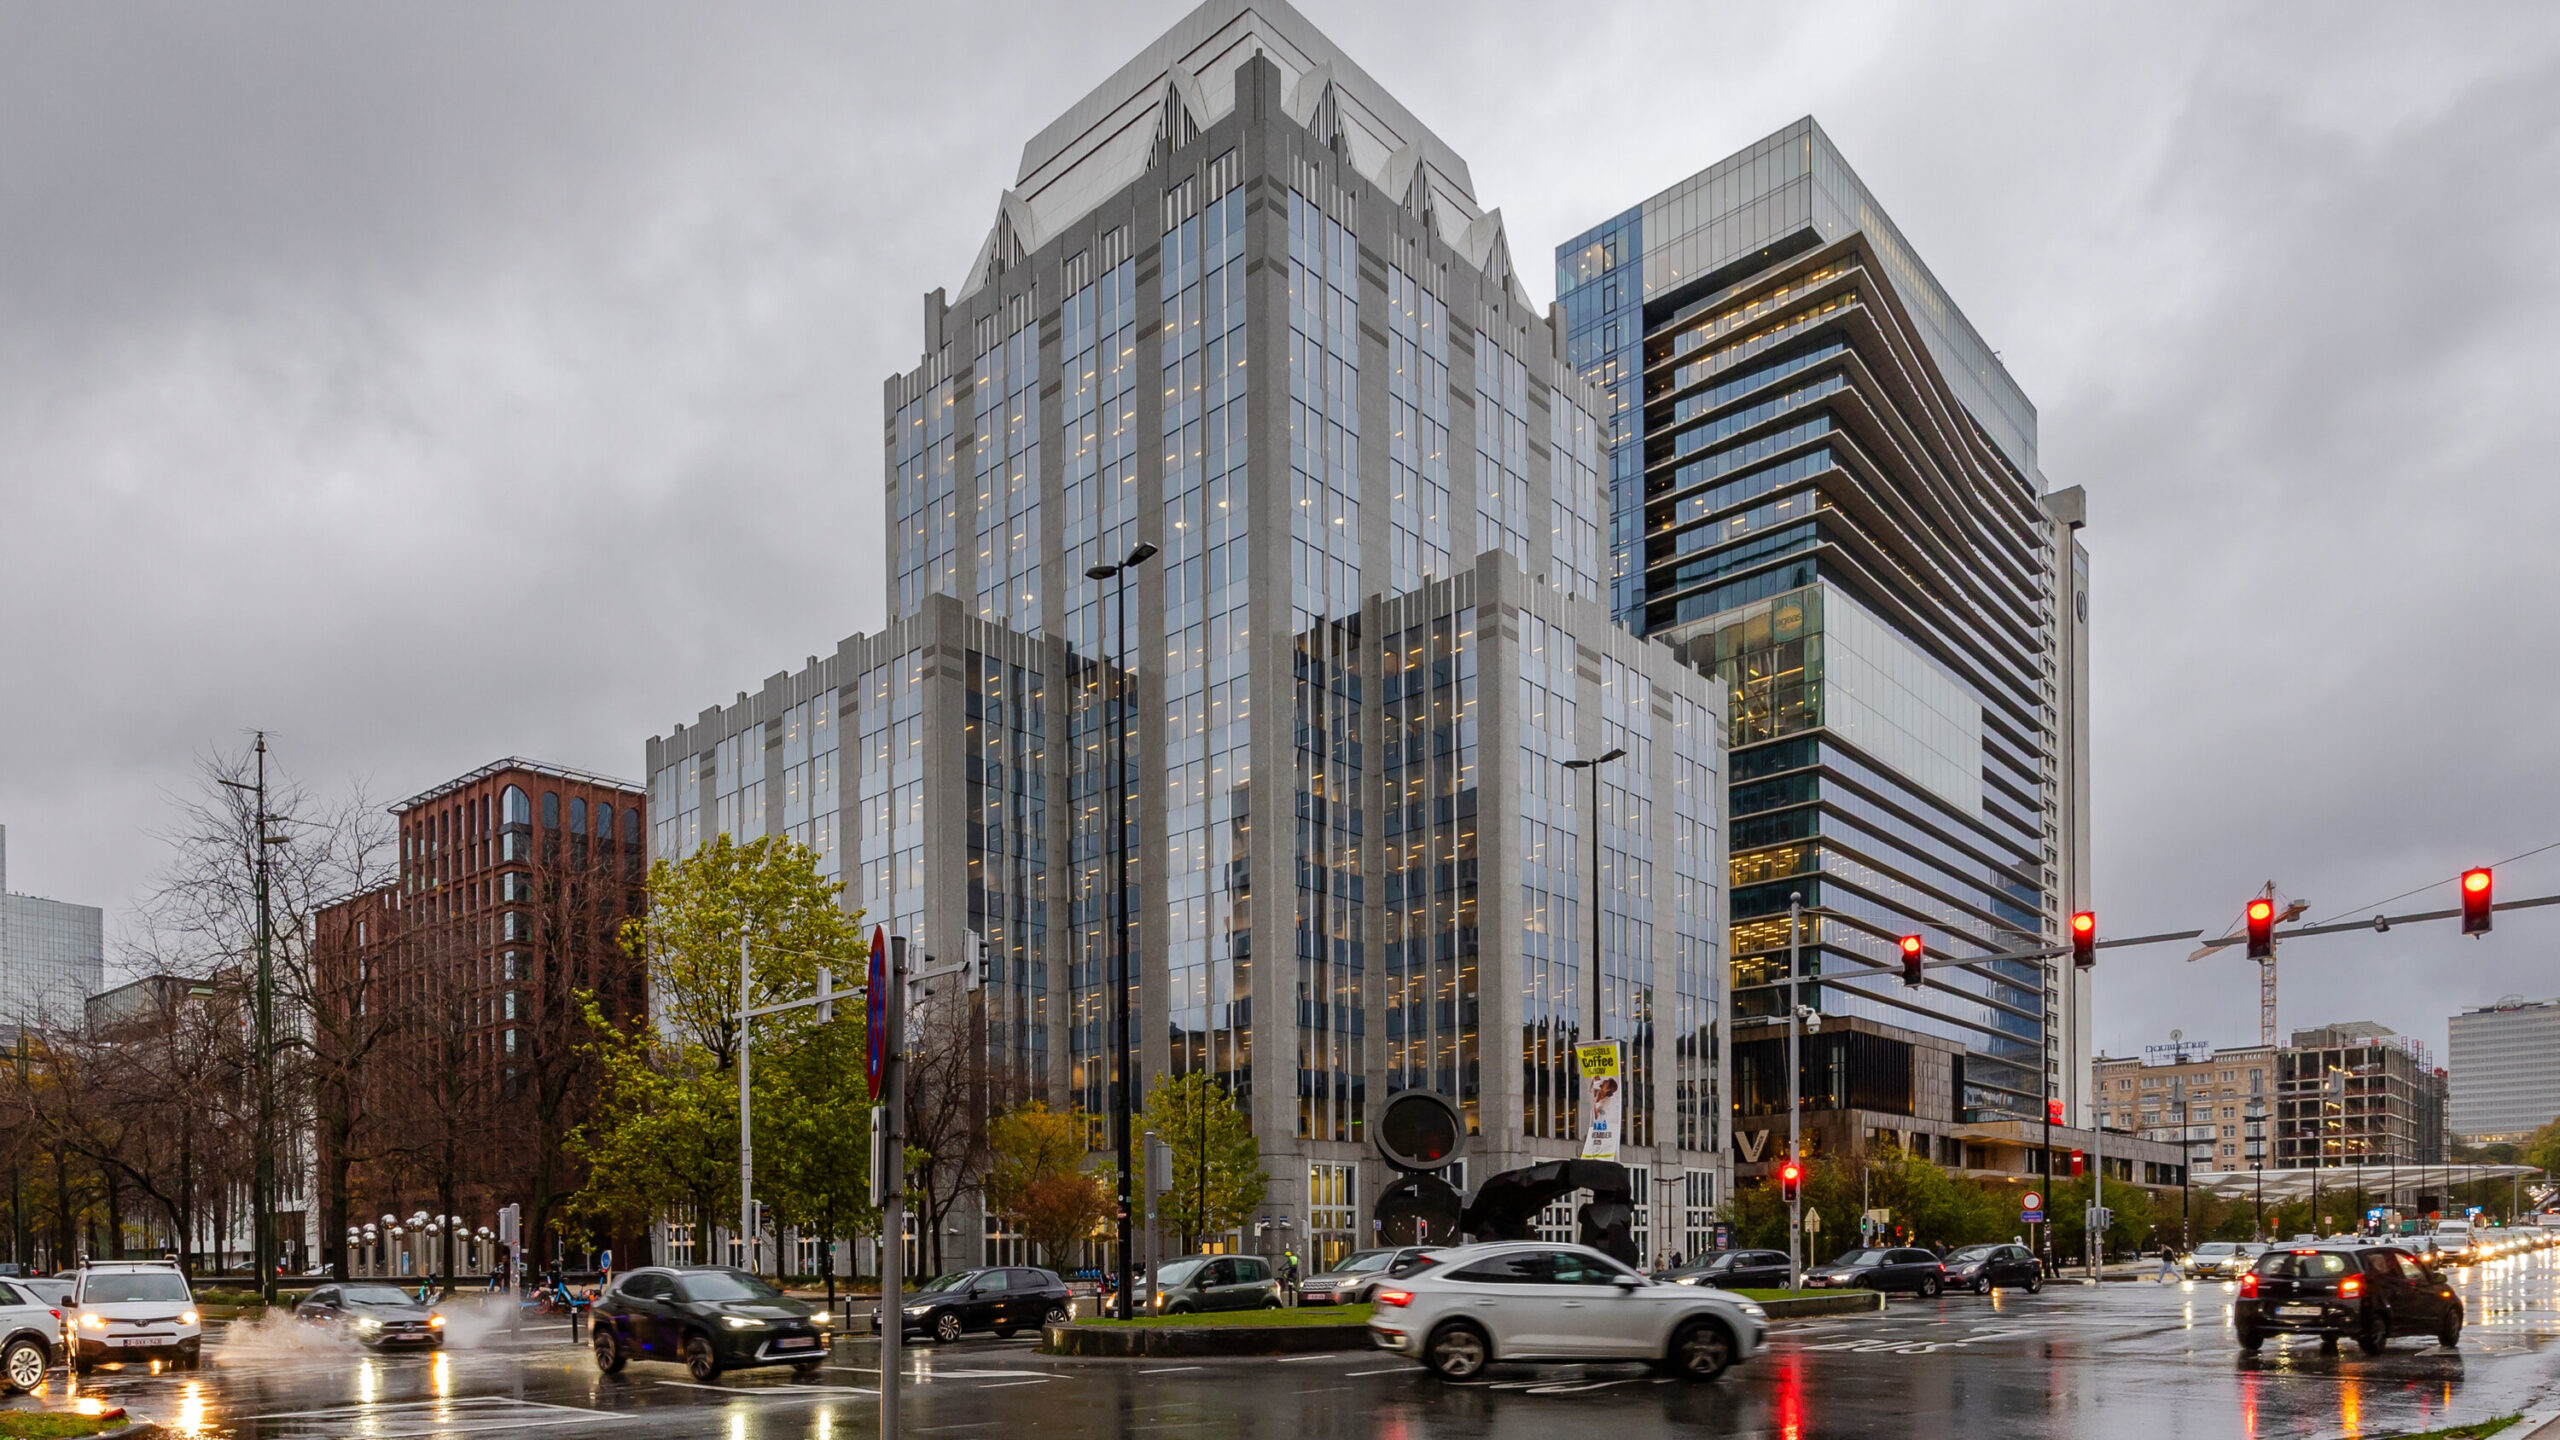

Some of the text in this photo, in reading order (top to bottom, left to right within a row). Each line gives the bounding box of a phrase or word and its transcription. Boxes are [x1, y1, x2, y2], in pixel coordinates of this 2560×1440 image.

[1583, 1047, 1610, 1057] BRUSSELS
[1582, 1055, 1614, 1068] Coffee
[1802, 1338, 1968, 1354] BUS
